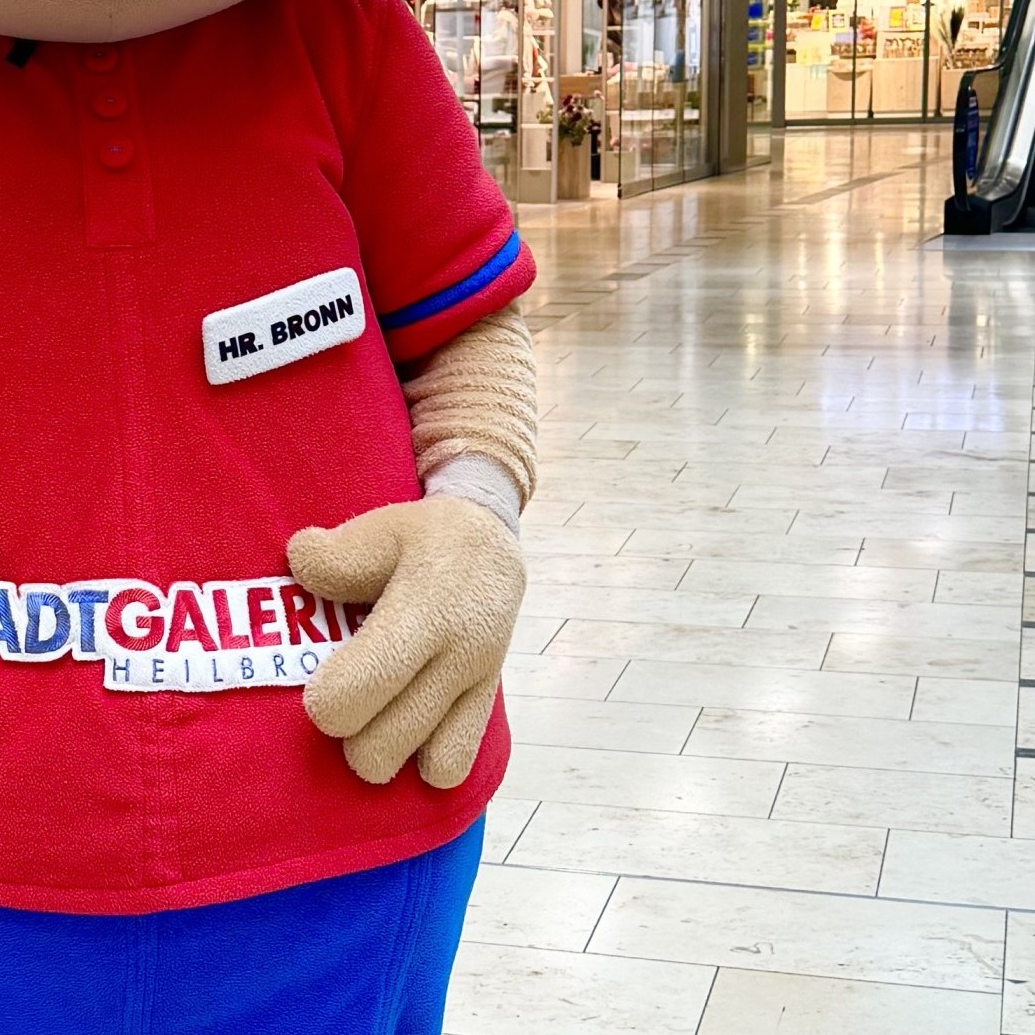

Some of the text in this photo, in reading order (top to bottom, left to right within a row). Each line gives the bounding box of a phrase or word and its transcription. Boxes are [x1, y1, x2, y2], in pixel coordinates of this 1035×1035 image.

[218, 294, 354, 362] HR. BRONN
[112, 648, 335, 684] HEILBRO
